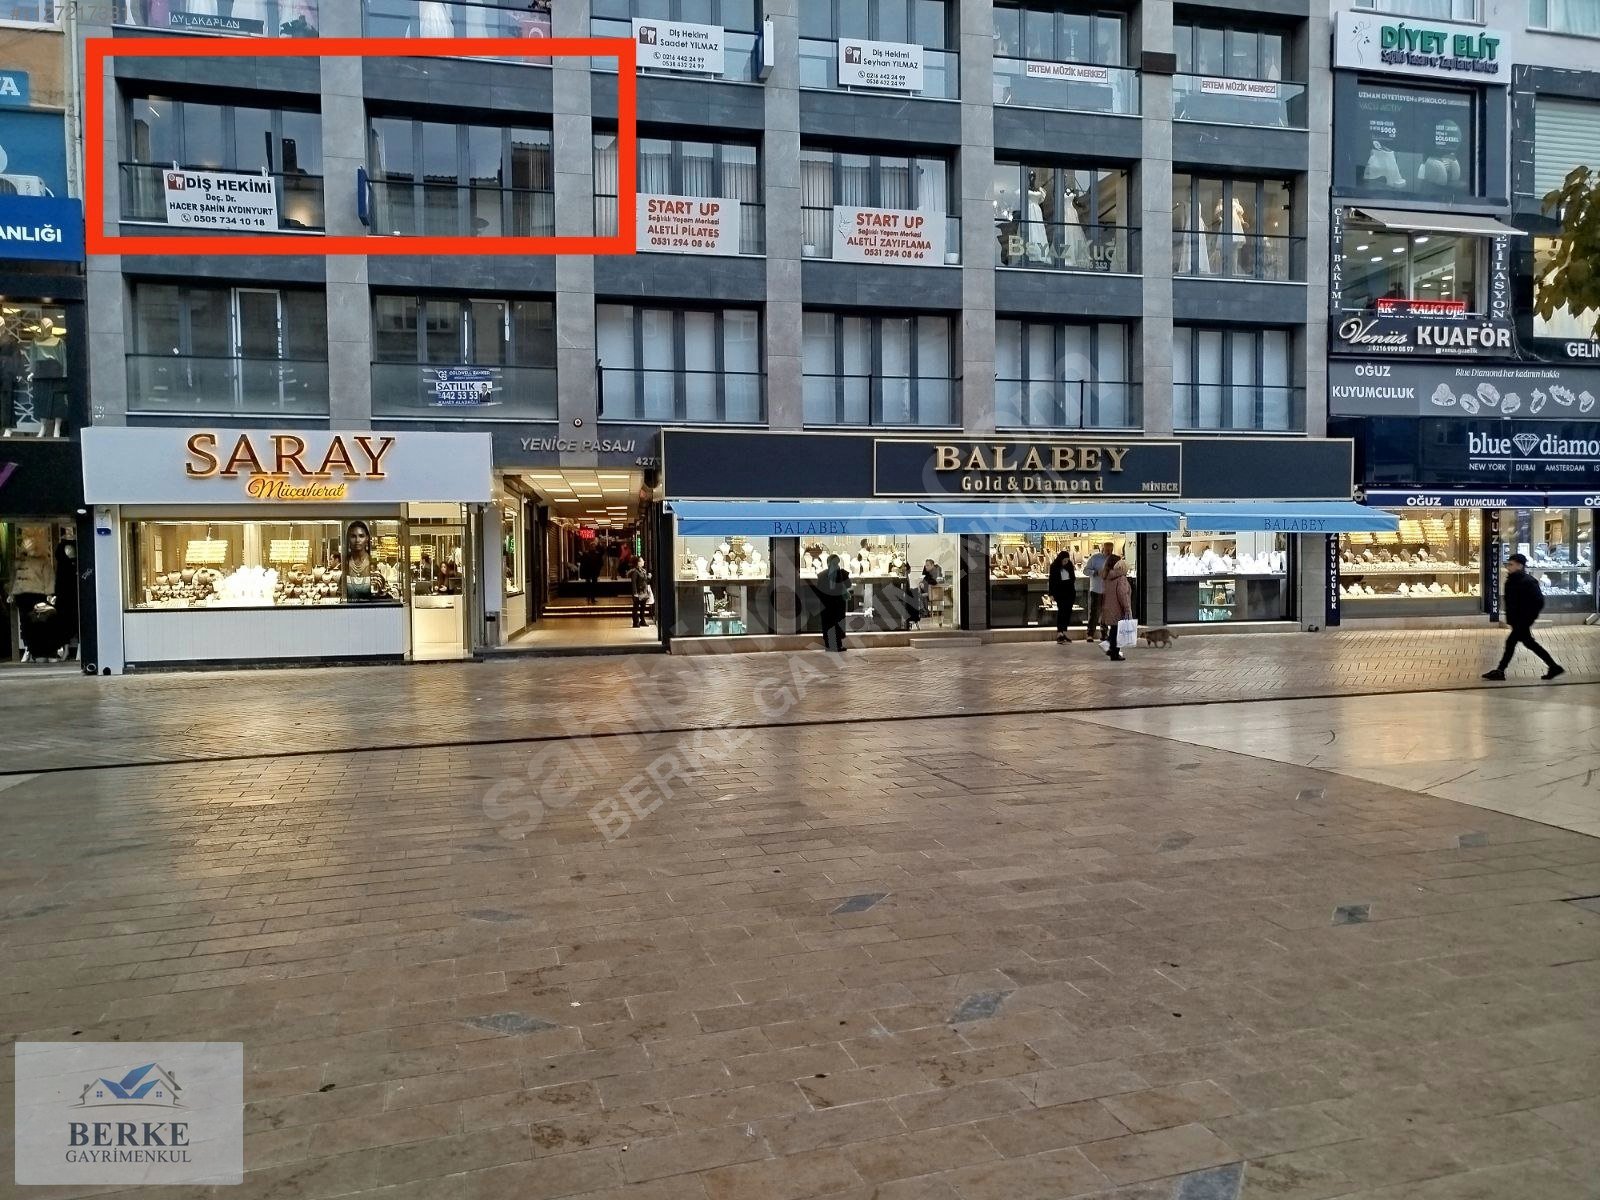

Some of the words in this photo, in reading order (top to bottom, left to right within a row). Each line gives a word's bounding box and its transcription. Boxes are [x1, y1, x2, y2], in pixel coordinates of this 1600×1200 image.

[660, 39, 687, 48] Saadet
[690, 42, 718, 51] YILMAZ
[1381, 22, 1448, 55] DİYET
[1453, 32, 1500, 60] ELİT
[863, 58, 890, 67] Seyhan
[893, 60, 918, 69] YILMAZ
[1028, 64, 1051, 75] ERTEM
[1052, 66, 1076, 77] MÜZİK
[1077, 68, 1107, 79] MERKEZİ
[1202, 80, 1224, 91] ERTEM
[186, 176, 211, 192] DİŞ
[217, 179, 272, 193] HEKİMİ
[206, 194, 223, 202] Doç.
[170, 202, 197, 211] HACER
[200, 202, 225, 213] ŞAHİN
[227, 205, 273, 215] AYDINYURT
[648, 199, 693, 214] START
[700, 203, 719, 216] UP
[194, 215, 217, 223] 0505
[220, 216, 237, 224] 734
[856, 213, 899, 227] START
[905, 216, 924, 228] UP
[1334, 208, 1342, 243] CİLT
[648, 225, 679, 235] ALETLİ
[682, 225, 719, 238] PİLATES
[847, 236, 876, 247] ALETLİ
[880, 239, 931, 249] ZAYIFLAMA
[1332, 255, 1342, 308] BAKIMI
[1339, 317, 1408, 344] Venüs
[1417, 322, 1511, 347] KUAFÖR
[1355, 362, 1391, 377] OĞUZ
[1455, 368, 1470, 377] Blue
[1471, 368, 1502, 377] Diamond
[1503, 369, 1514, 378] her
[437, 382, 476, 391] SATILIK
[1332, 385, 1415, 399] KUYUMCULUK
[441, 391, 456, 400] 442
[457, 391, 467, 399] 53
[469, 391, 479, 399] 53
[520, 435, 578, 452] YENİCE
[581, 440, 636, 452] PASAJI
[1468, 432, 1511, 454] blue
[1540, 434, 1600, 455] diamo
[185, 433, 396, 476] SARAY
[934, 445, 1130, 472] BALABEY
[1469, 463, 1486, 471] NEW
[1488, 463, 1506, 471] YORK
[247, 478, 345, 498] Mücevherat
[1406, 495, 1442, 506] OĞUZ
[1454, 498, 1507, 507] KUYUMCULUK
[774, 521, 848, 534] BALABEY
[1030, 519, 1099, 531] BALABEY
[1264, 519, 1326, 531] BALABEY
